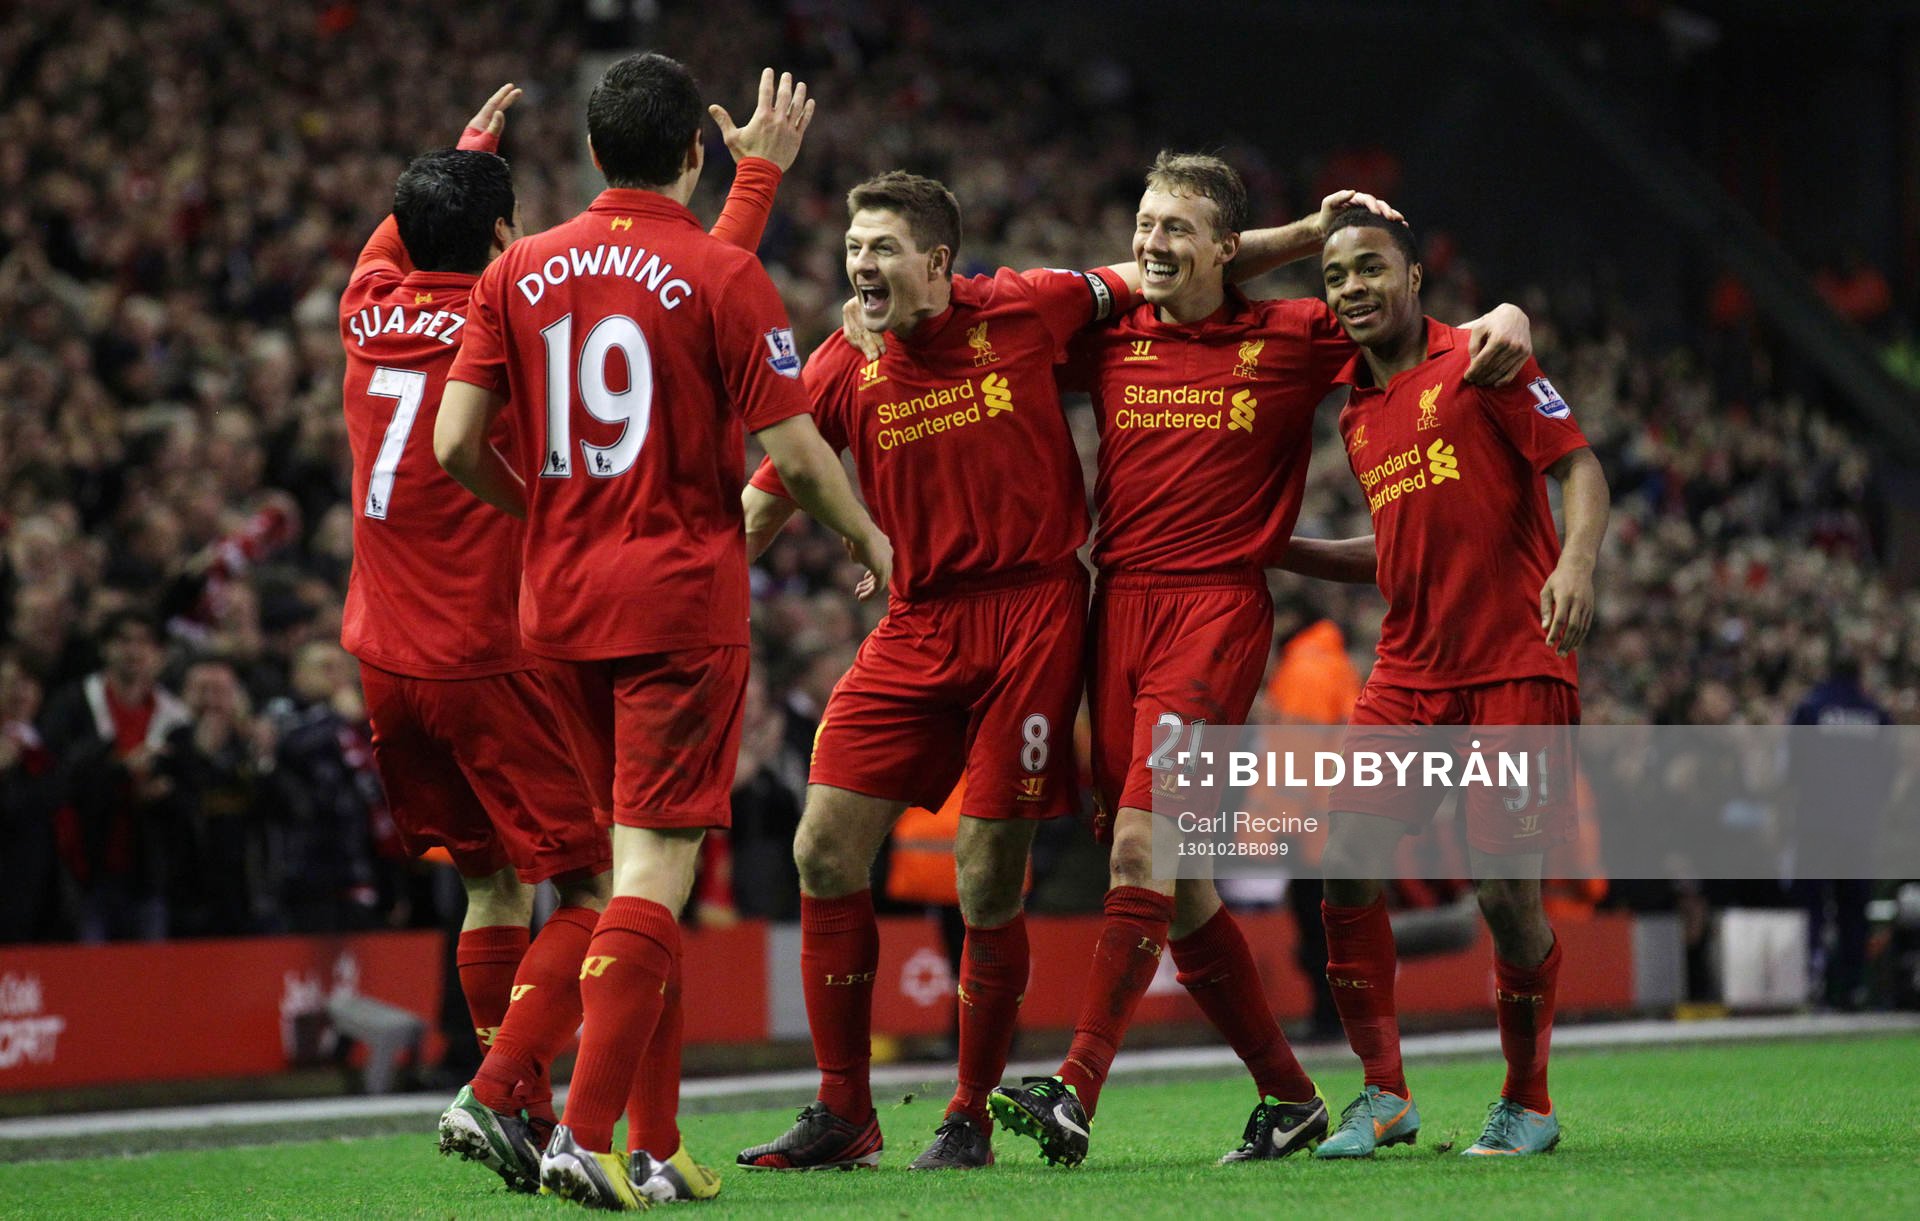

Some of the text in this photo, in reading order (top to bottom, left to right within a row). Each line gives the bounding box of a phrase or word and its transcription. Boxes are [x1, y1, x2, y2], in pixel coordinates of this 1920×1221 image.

[516, 244, 693, 311] DOWNING
[349, 304, 465, 347] SUAREZ
[540, 313, 653, 478] 19
[877, 379, 975, 425] Standard
[1123, 386, 1225, 405] Standard
[364, 366, 427, 519] 7
[877, 406, 981, 450] Chartered
[1115, 409, 1222, 430] Chartered
[1360, 445, 1421, 491] Standard
[1020, 713, 1050, 773] 8
[1145, 712, 1206, 776] 21
